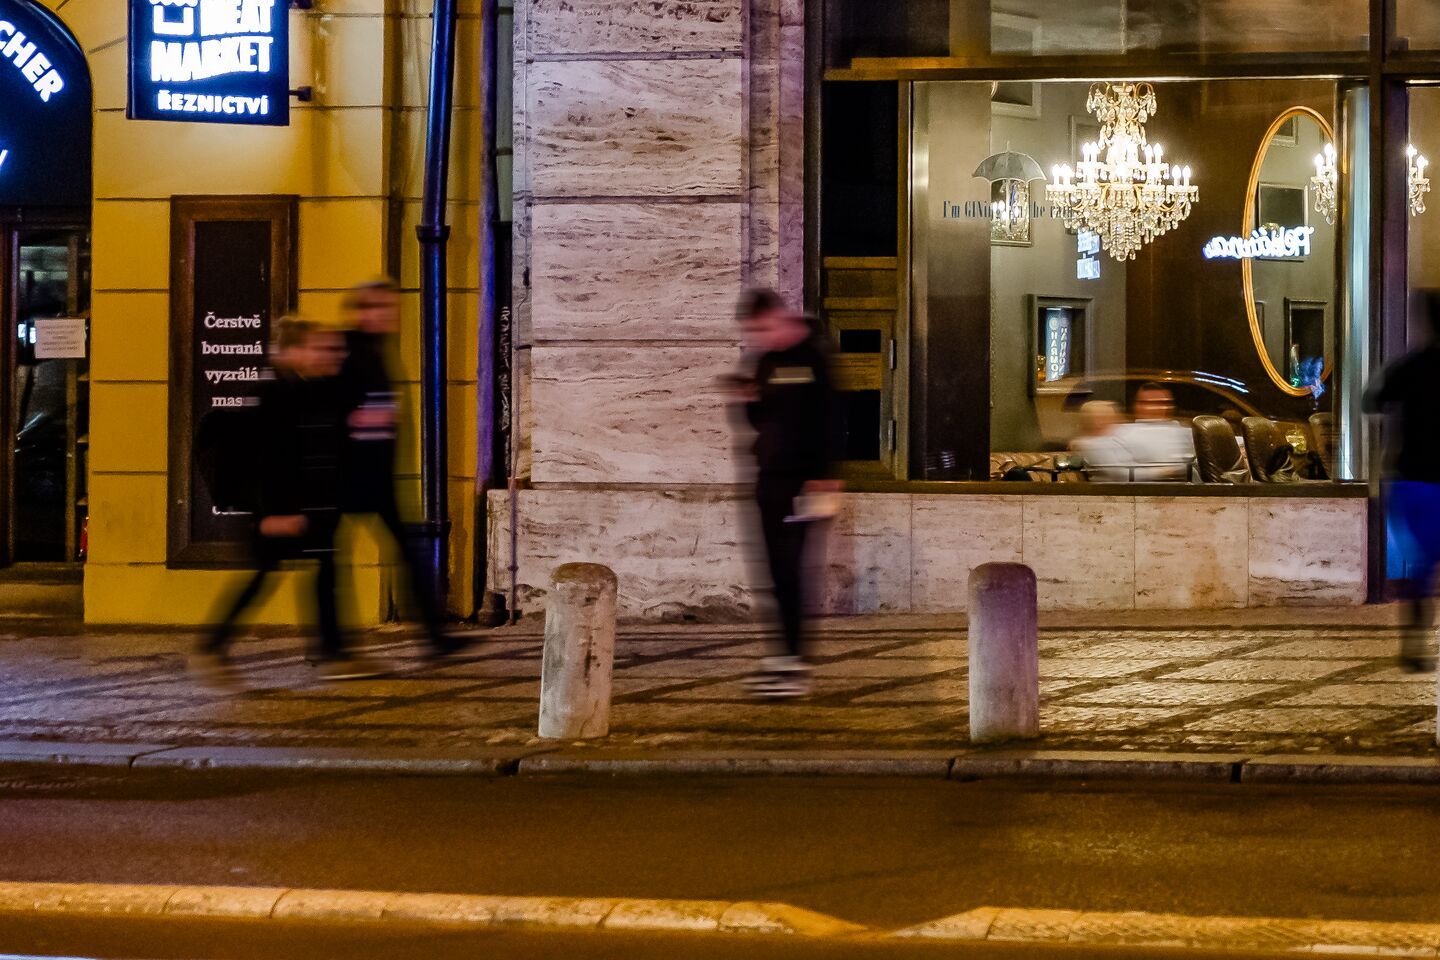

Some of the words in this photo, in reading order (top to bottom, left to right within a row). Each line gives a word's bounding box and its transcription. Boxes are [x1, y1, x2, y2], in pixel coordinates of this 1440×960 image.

[151, 36, 274, 81] MARKET
[157, 89, 269, 115] ŘEZNICTVÍ
[943, 201, 960, 218] I'm
[204, 311, 261, 329] Čerstvě
[201, 341, 263, 355] bouraná
[205, 366, 259, 384] vyzrálá
[211, 396, 252, 407] mas
